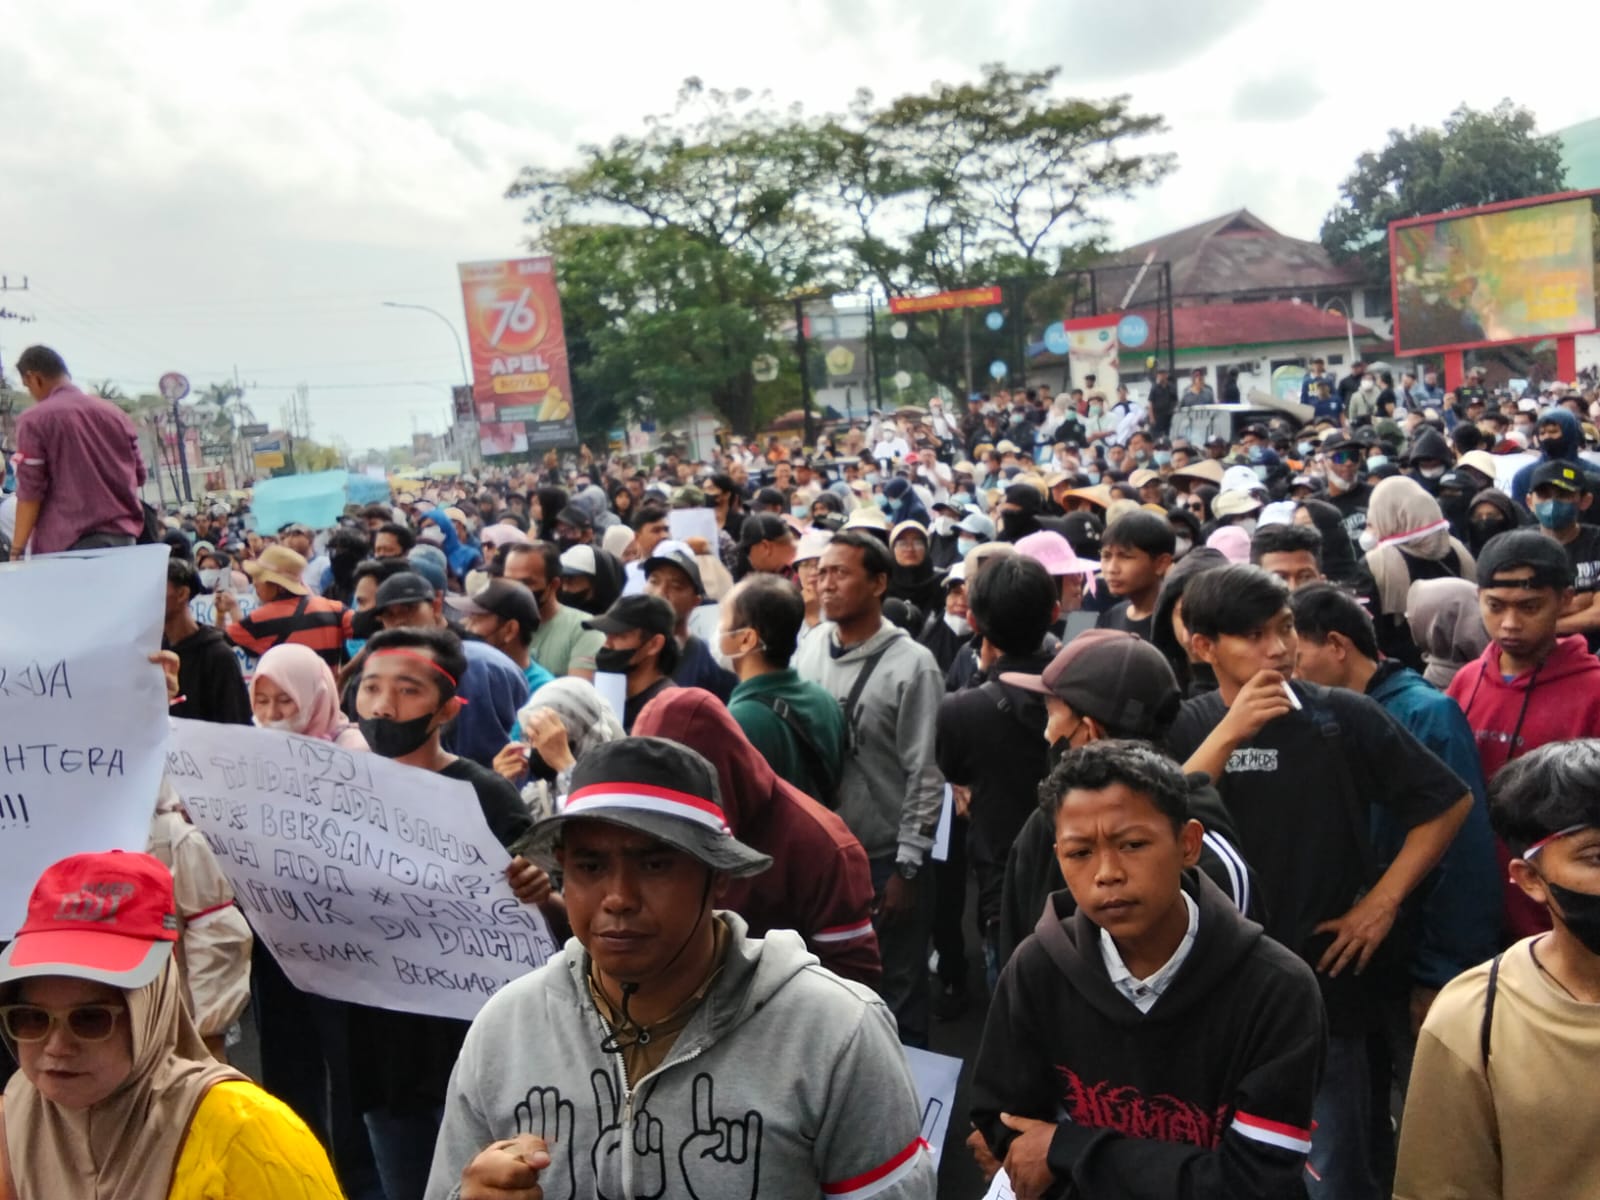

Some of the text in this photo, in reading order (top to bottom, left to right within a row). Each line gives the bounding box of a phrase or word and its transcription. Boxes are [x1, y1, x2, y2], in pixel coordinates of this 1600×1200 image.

[485, 287, 535, 347] 76
[490, 356, 549, 375] APEL
[332, 783, 389, 832] ADA
[394, 807, 488, 866] BAHU
[274, 849, 354, 897] ADA
[370, 915, 422, 941] DI
[392, 955, 512, 997] BERSUAR
